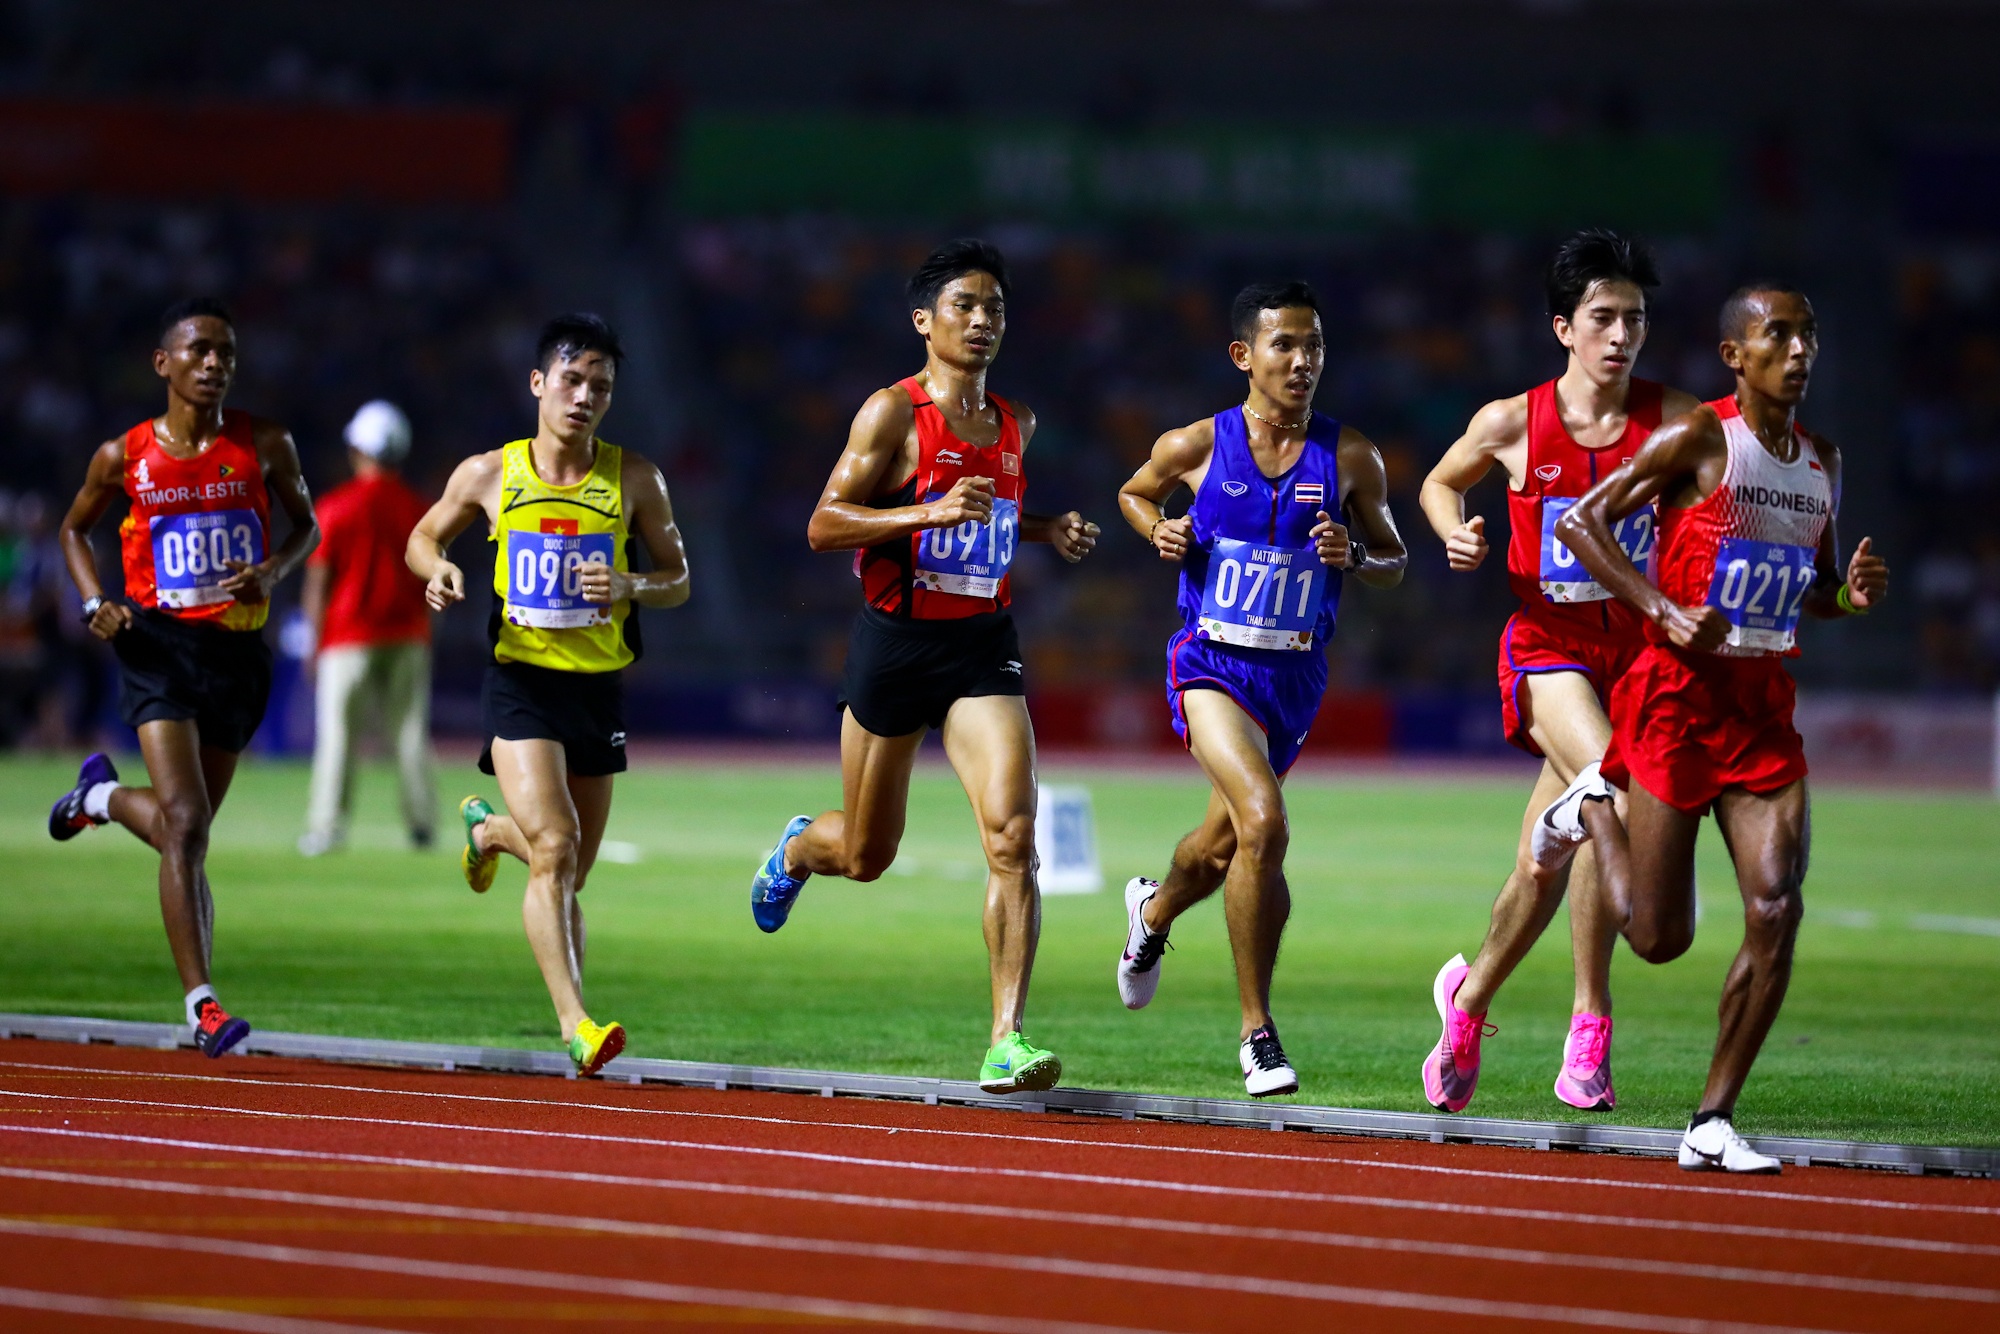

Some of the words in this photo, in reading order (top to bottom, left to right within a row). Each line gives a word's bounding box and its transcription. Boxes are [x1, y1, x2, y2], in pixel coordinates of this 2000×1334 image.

[138, 481, 248, 507] TIMOR-LESTE
[1735, 485, 1828, 516] INDONESIA
[162, 524, 254, 578] 0803
[930, 516, 1014, 566] 0913
[1251, 549, 1293, 566] NATTAWUT
[516, 549, 607, 596] 090
[963, 563, 990, 576] VIETNAM
[1215, 558, 1314, 618] 0711
[1719, 558, 1812, 617] 0212
[1246, 614, 1277, 628] THAILAND
